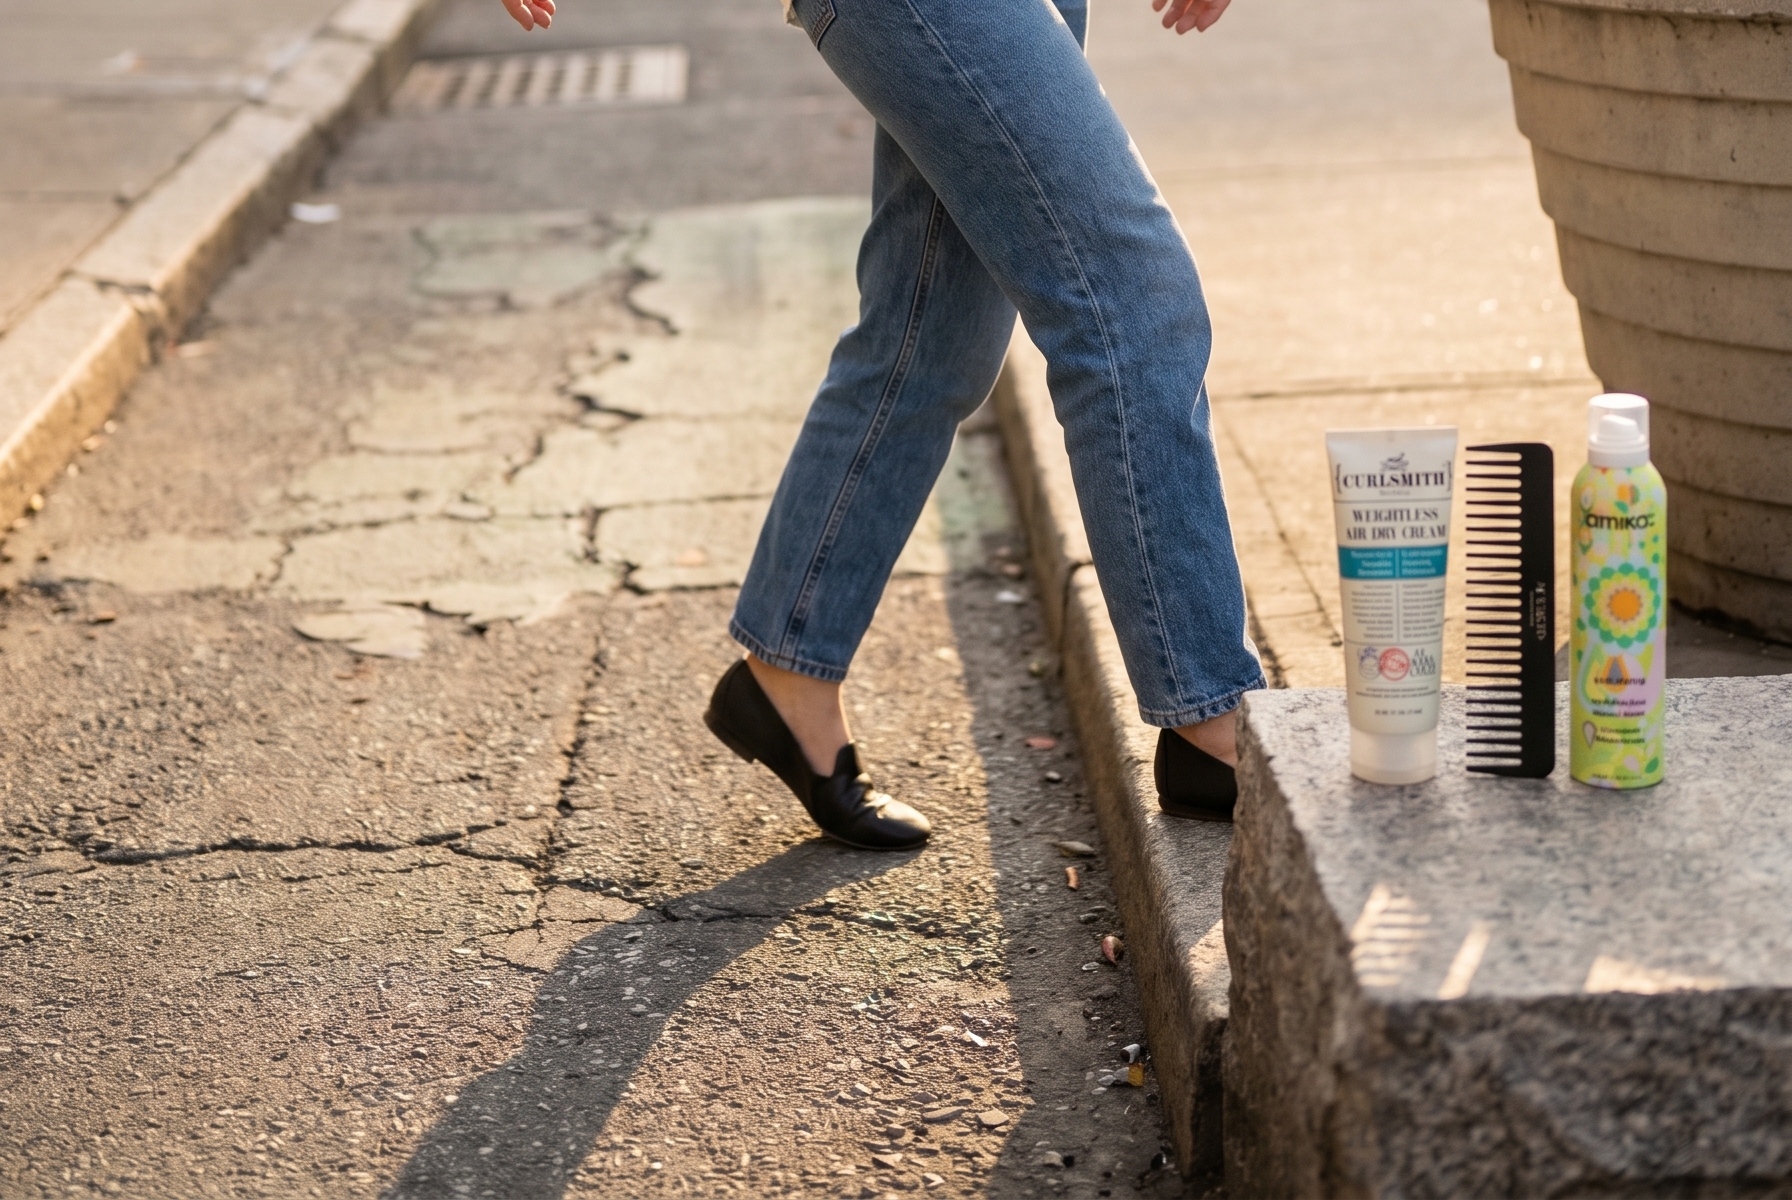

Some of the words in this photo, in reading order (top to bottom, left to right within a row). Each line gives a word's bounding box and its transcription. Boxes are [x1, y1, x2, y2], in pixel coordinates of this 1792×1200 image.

[1352, 507, 1439, 523] WEIGHTLESS
[1346, 527, 1367, 541] AIR
[1372, 526, 1397, 541] DRY
[1402, 524, 1447, 540] CREAM
